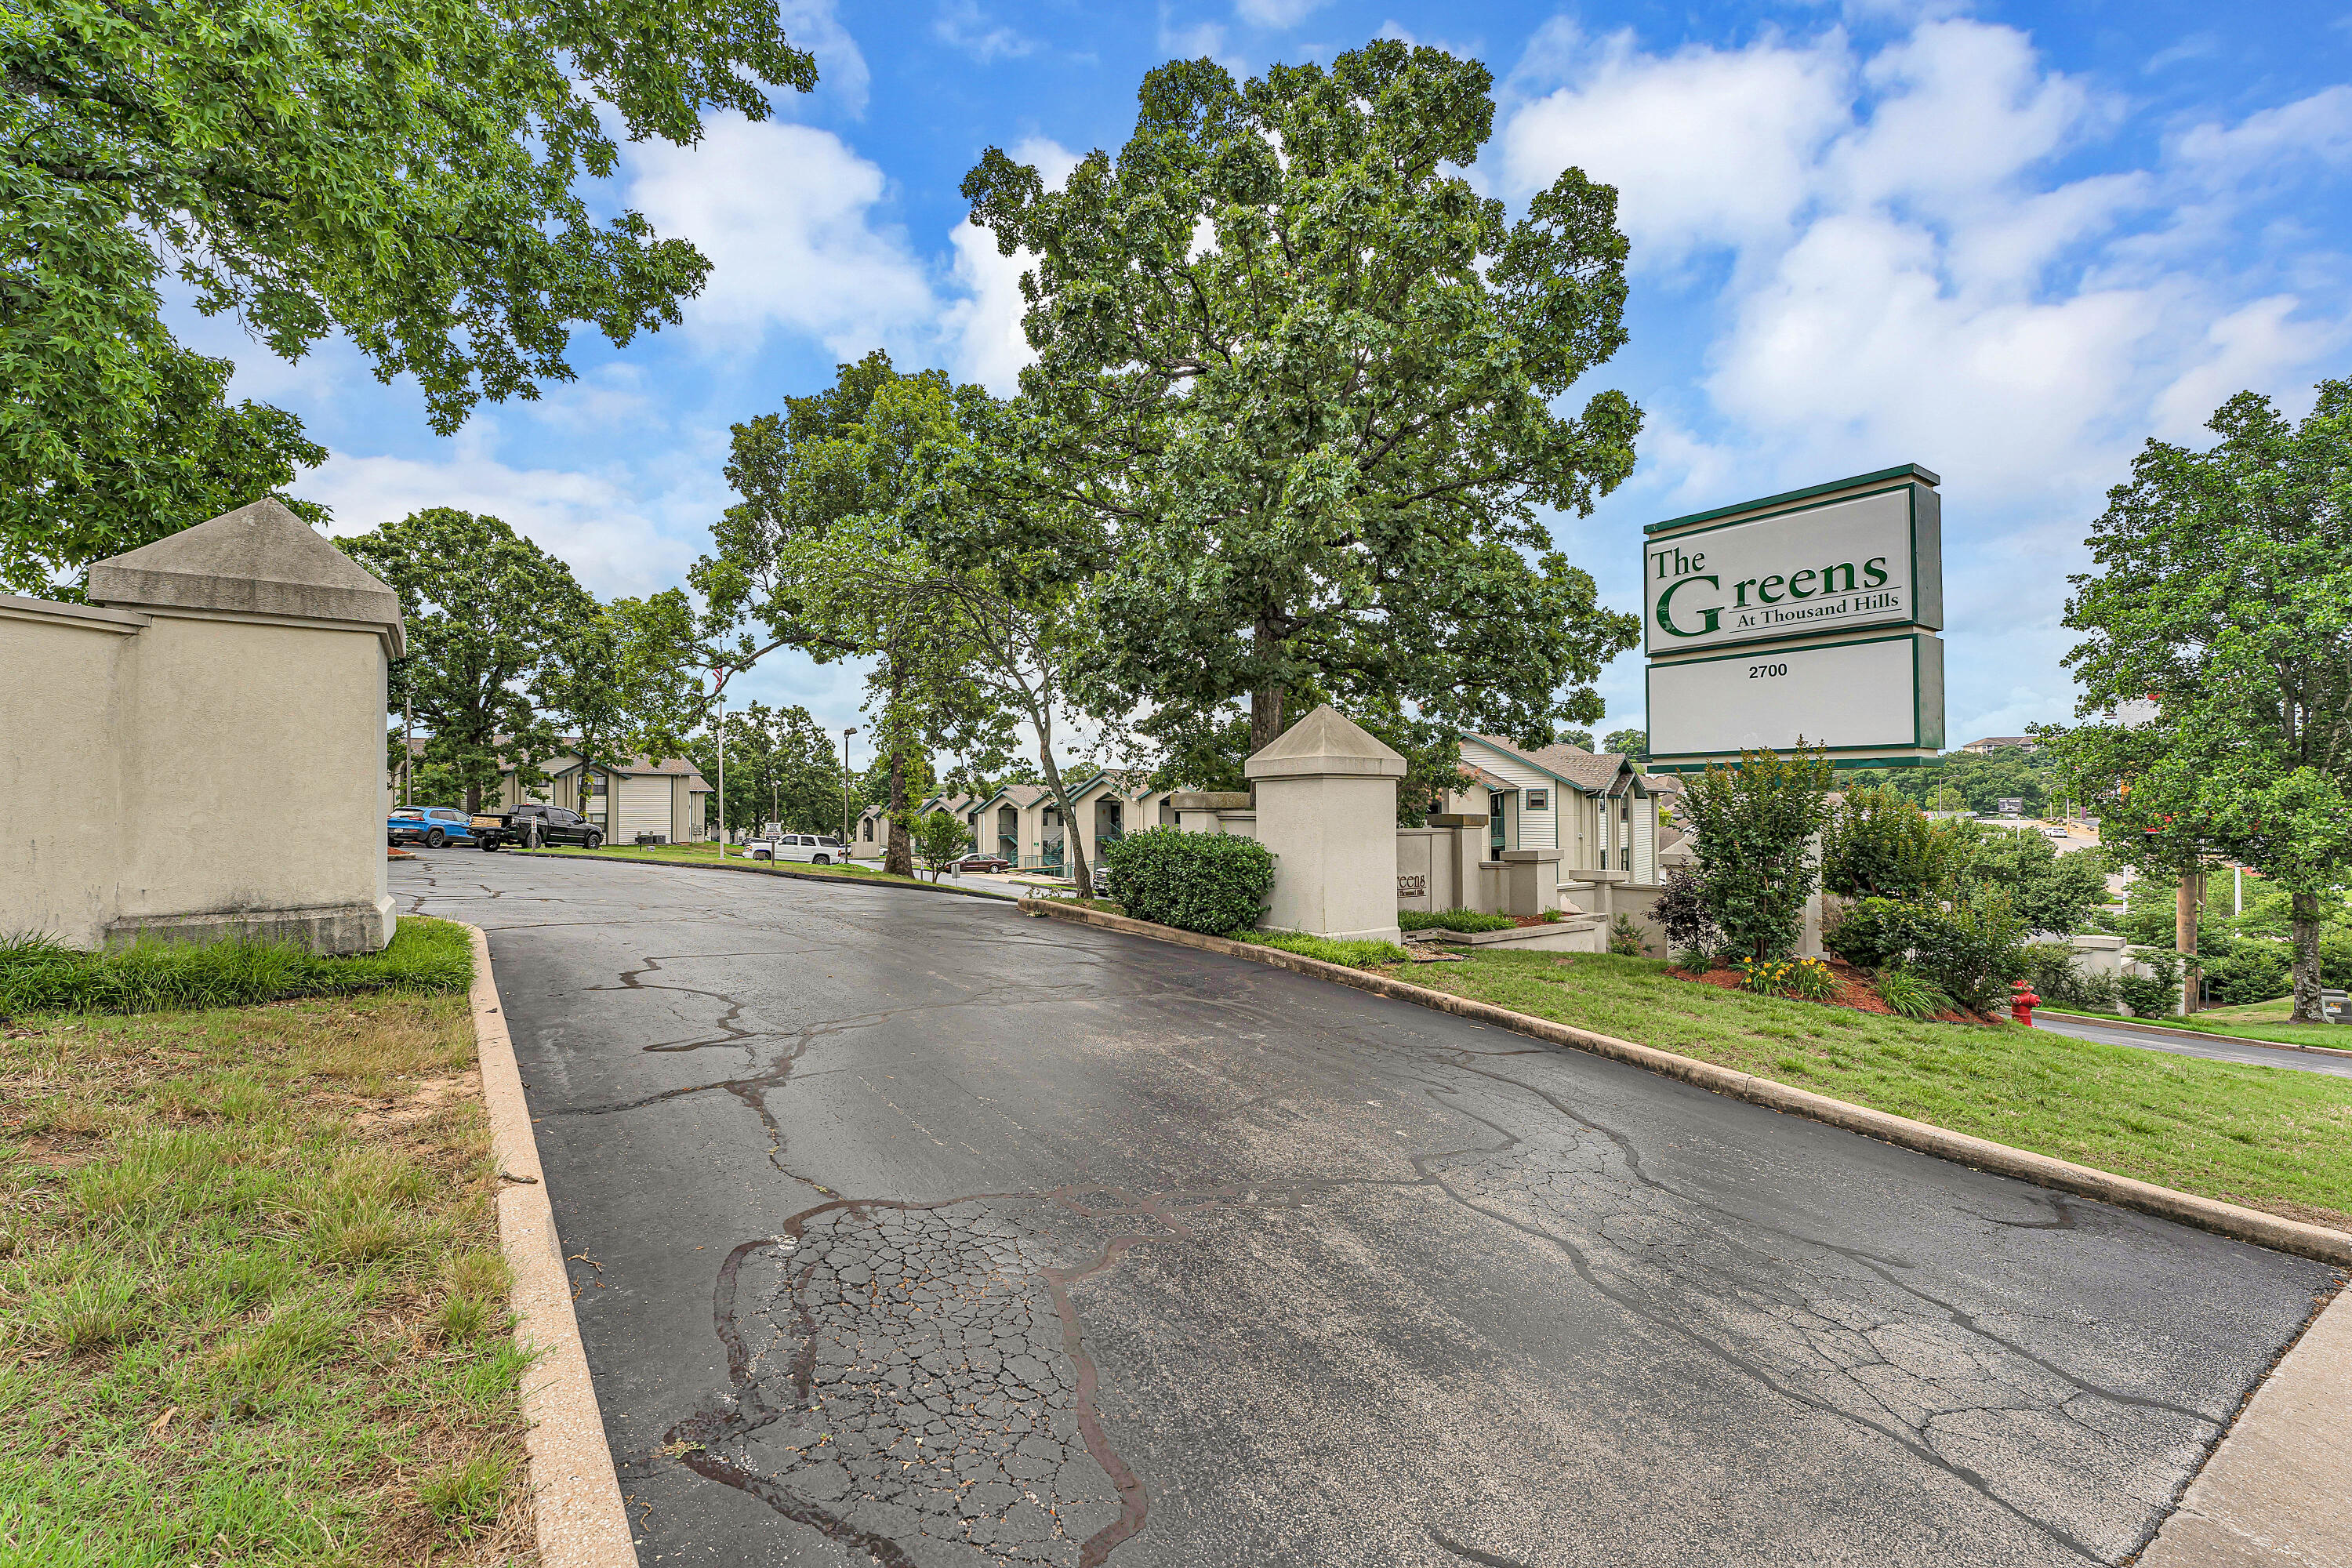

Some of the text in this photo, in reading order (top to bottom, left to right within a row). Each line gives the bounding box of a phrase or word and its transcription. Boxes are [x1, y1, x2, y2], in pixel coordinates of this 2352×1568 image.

[1650, 546, 1706, 579] The
[1656, 557, 1888, 637] Greens
[1737, 592, 1899, 628] At Thousand Hills
[1748, 663, 1788, 679] 2700
